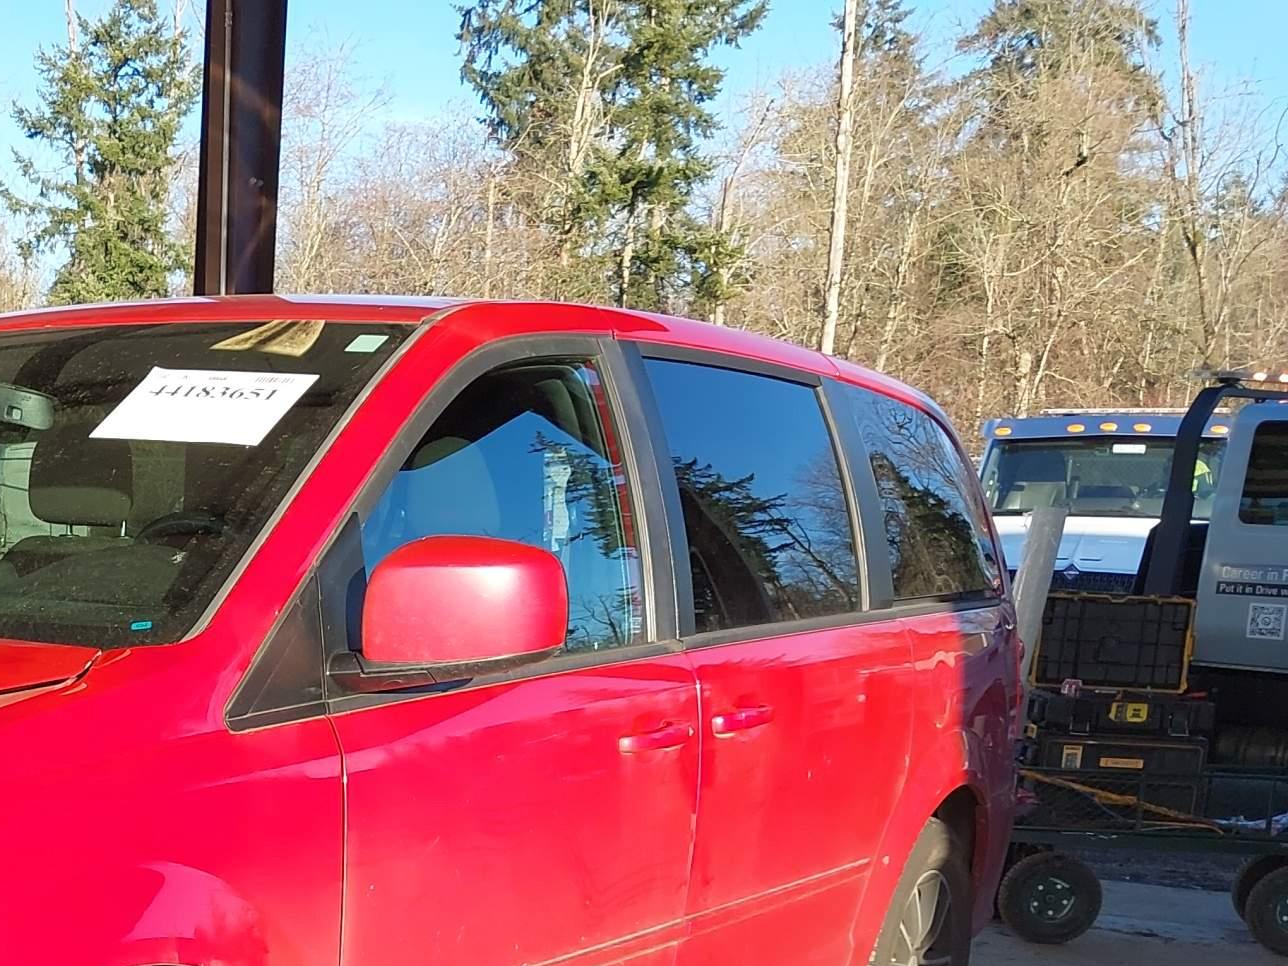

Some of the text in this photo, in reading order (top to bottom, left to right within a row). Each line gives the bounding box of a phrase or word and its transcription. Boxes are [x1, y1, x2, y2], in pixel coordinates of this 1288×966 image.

[148, 384, 279, 400] 44183651
[1222, 566, 1264, 580] Career
[1266, 567, 1279, 581] in
[1219, 583, 1235, 593] Put
[1236, 583, 1243, 593] it
[1245, 584, 1254, 594] in
[1255, 585, 1279, 596] Drive
